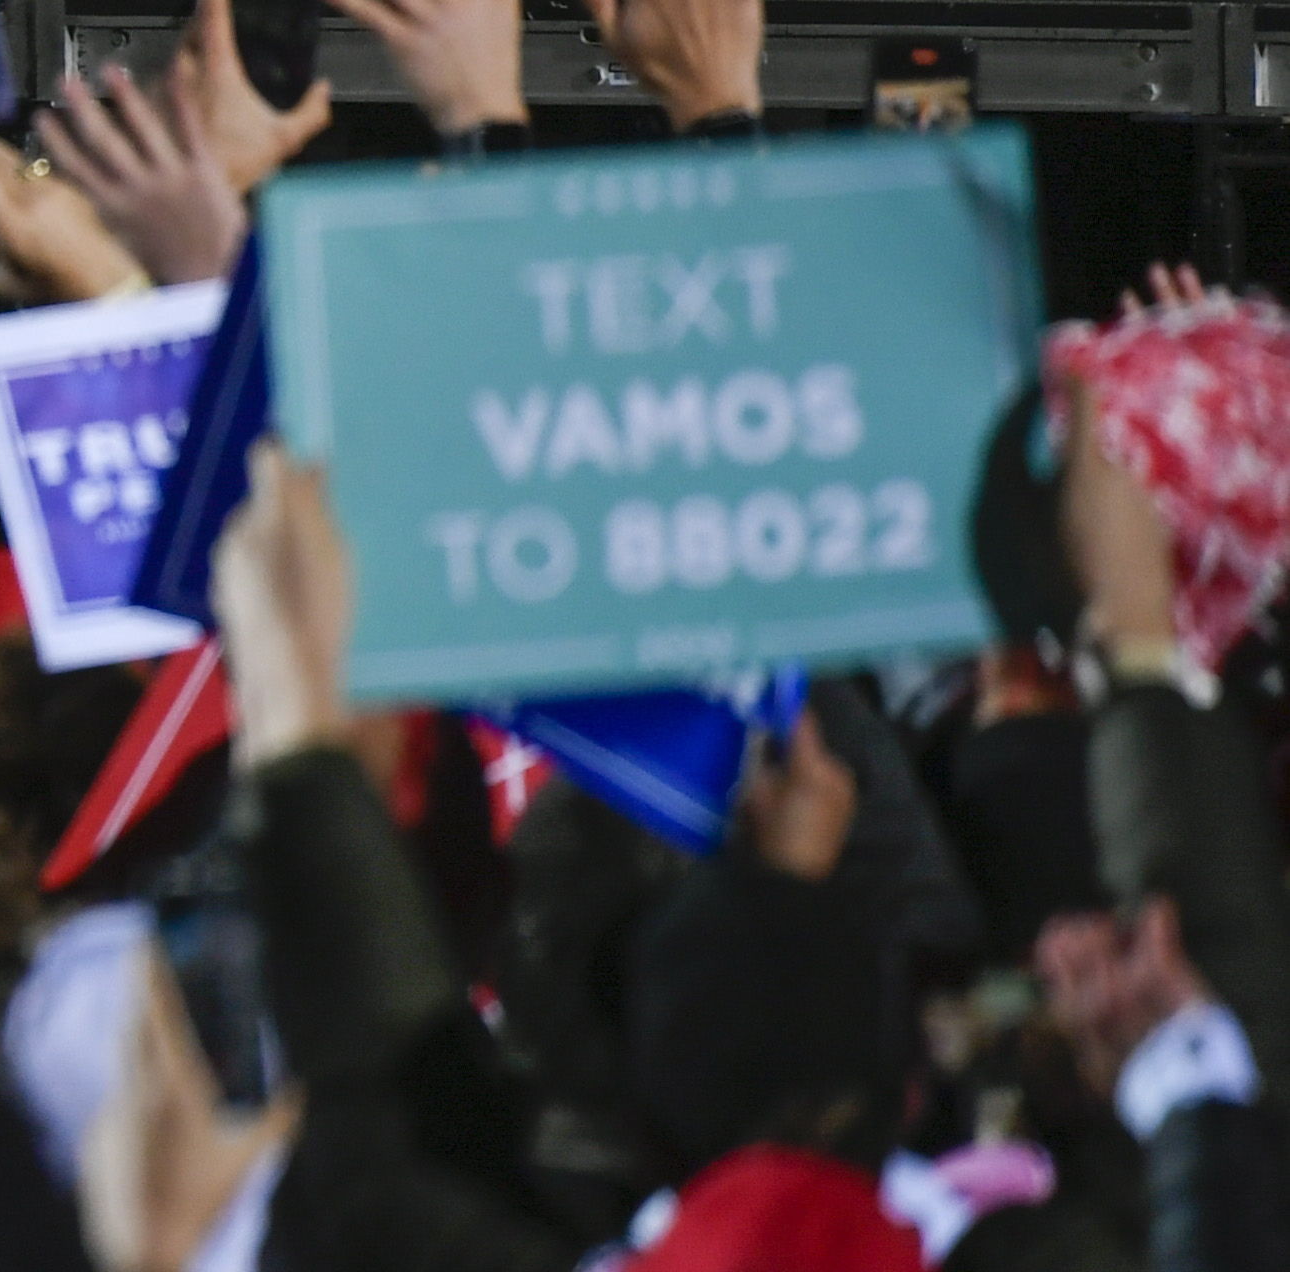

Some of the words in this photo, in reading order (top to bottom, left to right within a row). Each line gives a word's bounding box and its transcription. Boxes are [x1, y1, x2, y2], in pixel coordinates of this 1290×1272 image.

[521, 243, 792, 357] TEXT
[468, 363, 865, 482] VAMOS
[430, 502, 578, 606] TO
[605, 477, 935, 595] 88022
